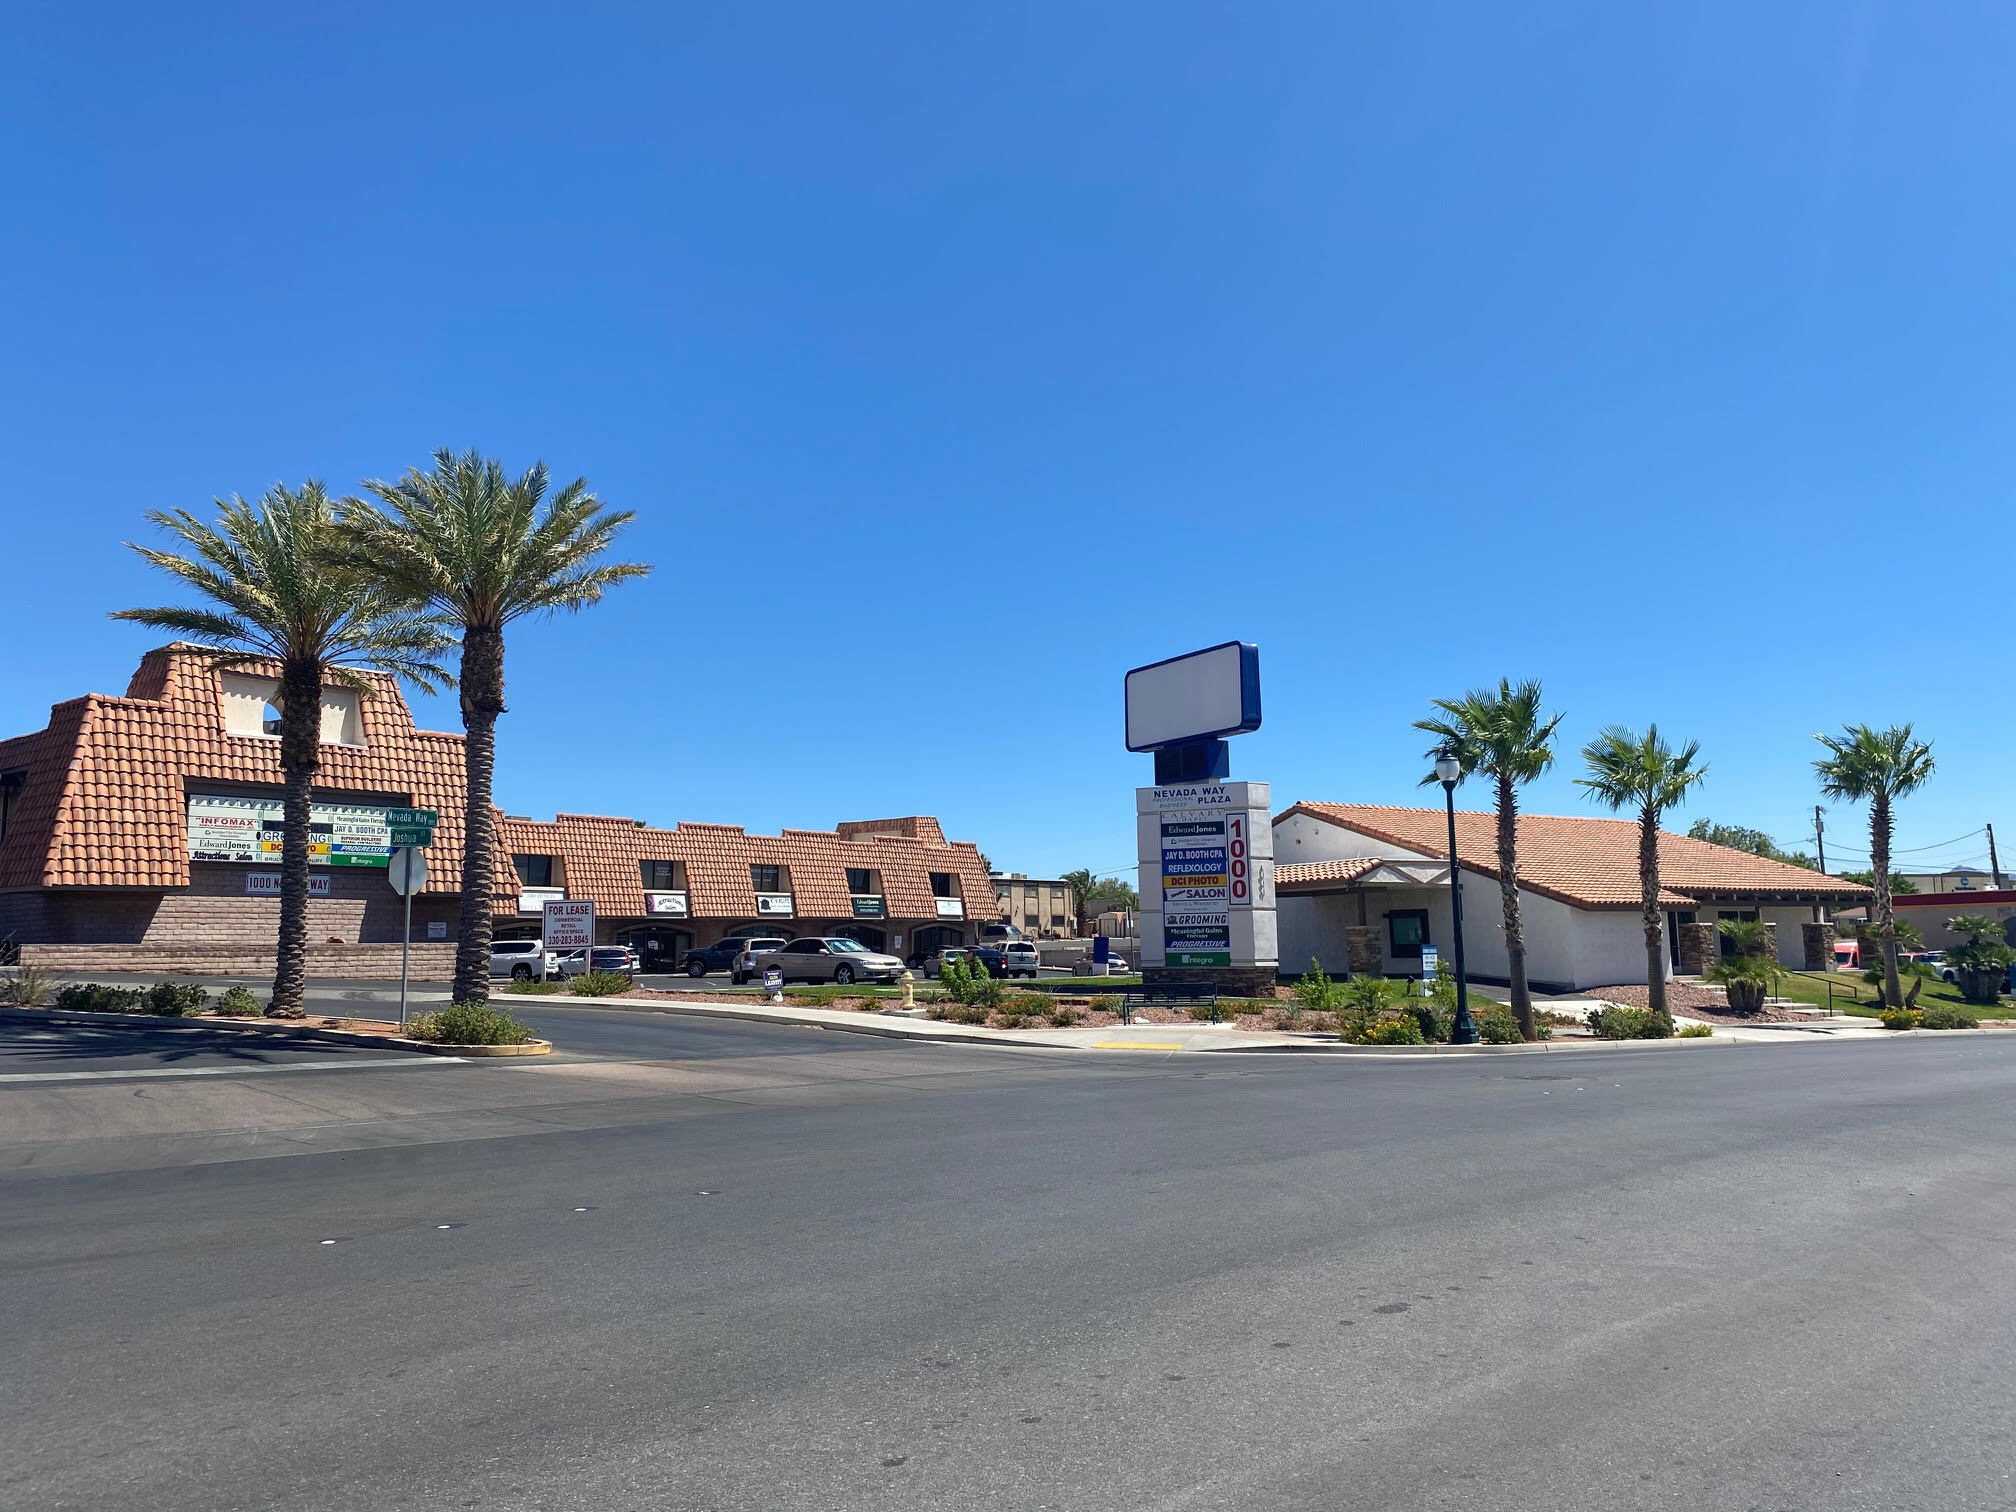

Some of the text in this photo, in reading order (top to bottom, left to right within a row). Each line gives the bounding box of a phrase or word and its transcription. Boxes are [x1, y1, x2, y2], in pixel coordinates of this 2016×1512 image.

[1154, 786, 1225, 798] NEVADA WAY
[1198, 796, 1231, 804] PLAZA
[387, 811, 412, 822] Nevada
[415, 813, 428, 824] Way
[1162, 810, 1223, 819] CALVARY
[392, 832, 416, 843] Joshua
[1165, 850, 1223, 860] JAY D. BOOTH CPA
[1230, 819, 1247, 898] 1000
[1168, 863, 1222, 872] REFLEXOLOGY
[249, 878, 270, 888] 1000
[310, 879, 328, 890] WAY
[1171, 876, 1218, 886] DCI PHOTO
[1186, 889, 1225, 898] SALON
[548, 906, 564, 915] FOR
[566, 906, 589, 914] LEASE
[1179, 915, 1227, 925] GROOMING
